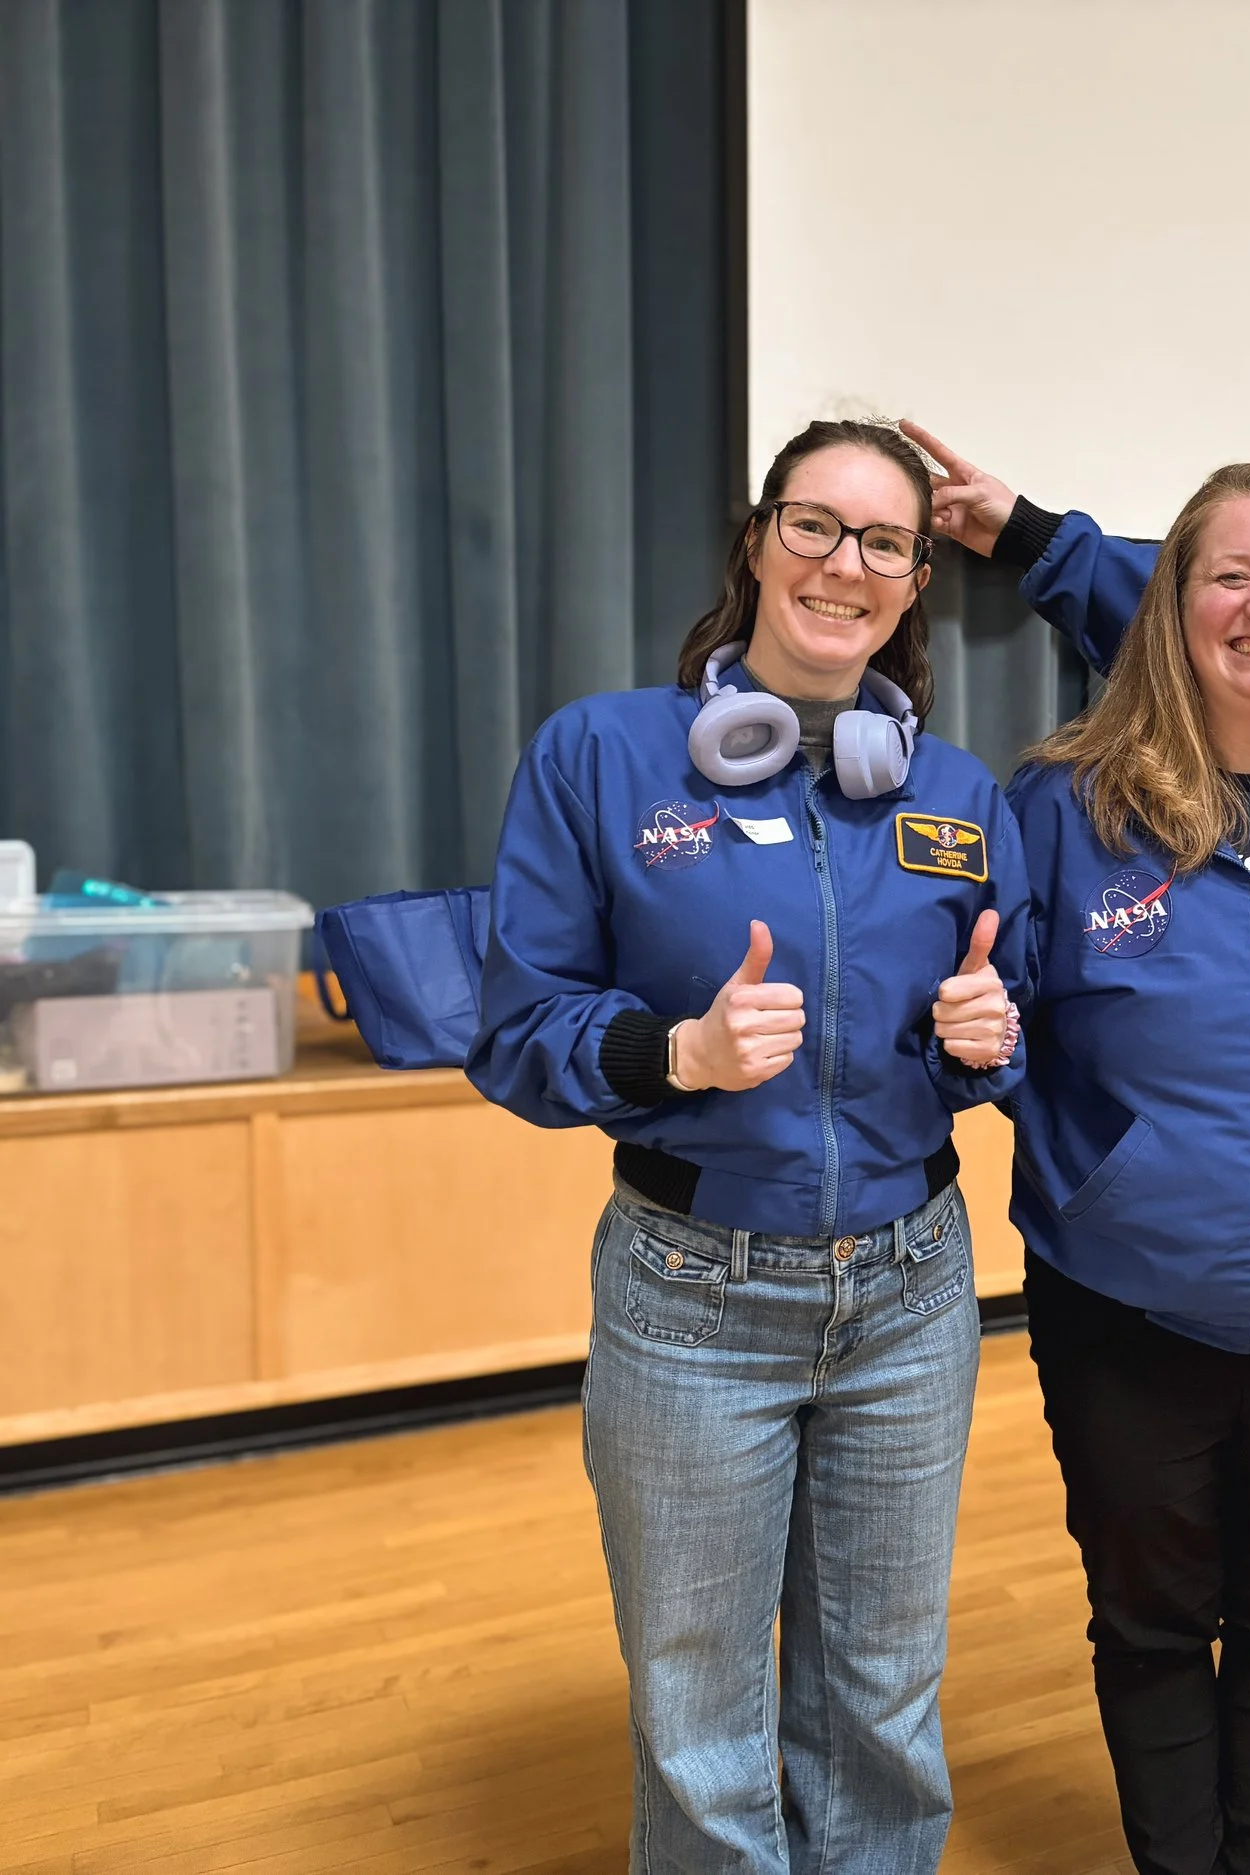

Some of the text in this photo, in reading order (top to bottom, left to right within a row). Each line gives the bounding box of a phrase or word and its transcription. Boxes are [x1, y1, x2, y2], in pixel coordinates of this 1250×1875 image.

[642, 827, 712, 845] NASA
[930, 847, 968, 862] CATHERINE
[937, 856, 962, 869] HOVDA
[1089, 899, 1167, 930] NASA
